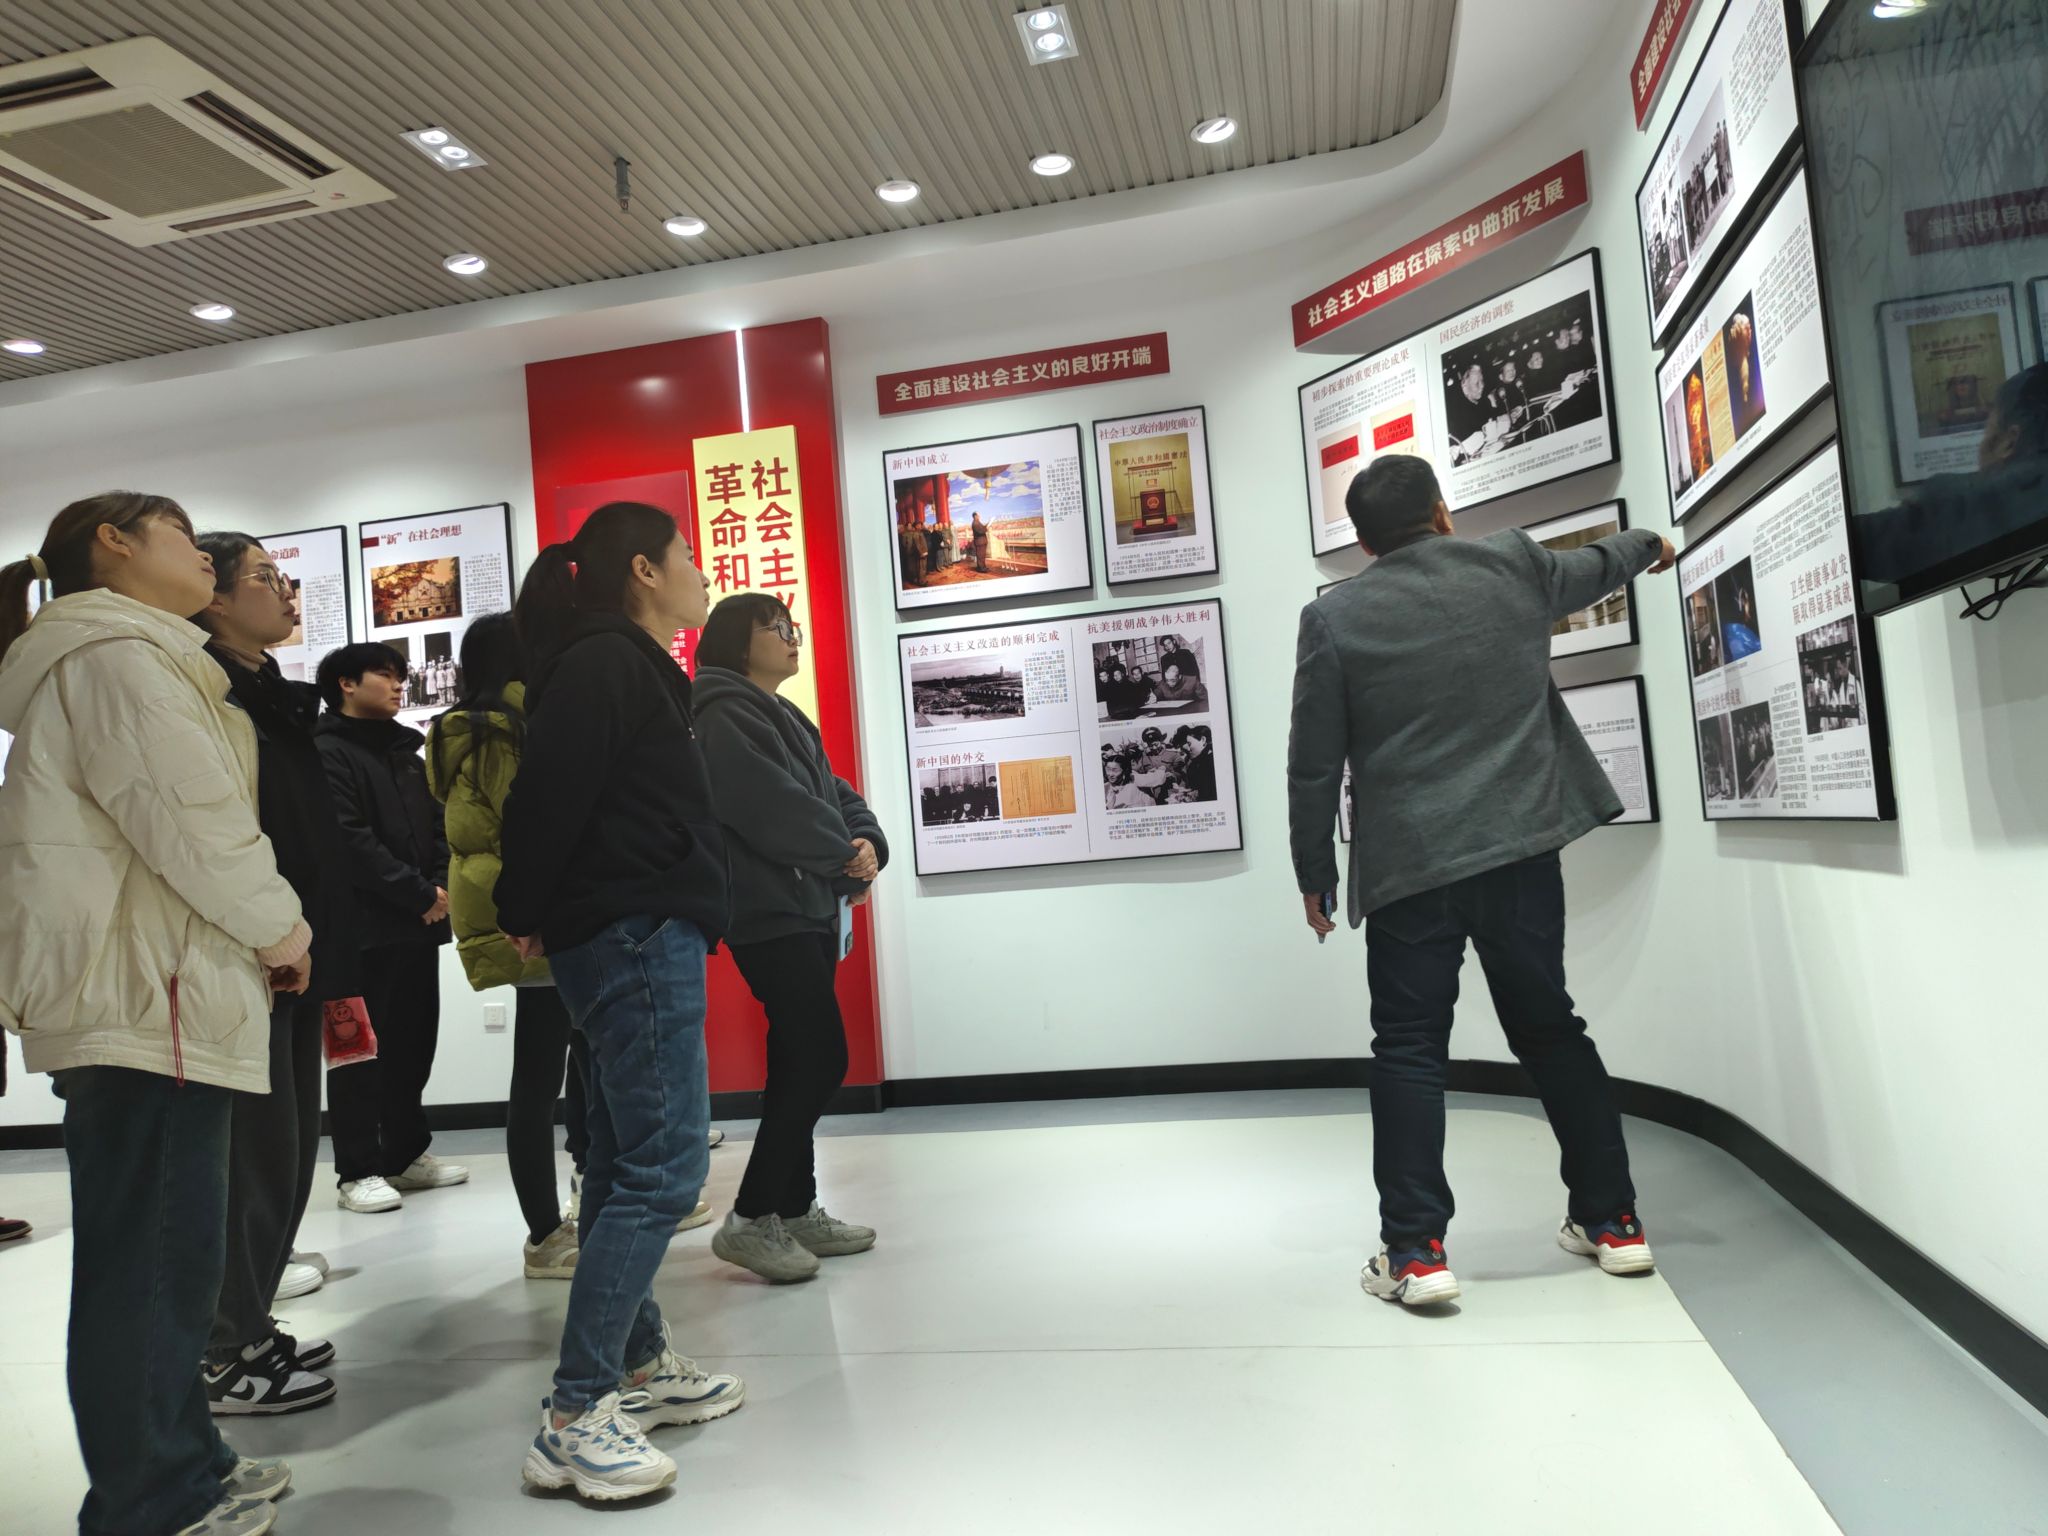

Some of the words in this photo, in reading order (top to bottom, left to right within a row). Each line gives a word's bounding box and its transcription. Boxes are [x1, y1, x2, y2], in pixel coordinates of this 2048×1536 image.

[1308, 177, 1565, 328] 社会主义道路在探索中曲折发展
[1440, 300, 1514, 345] 国民经济的调整
[894, 346, 1152, 402] 全面建设社会主义的良好开端
[1099, 416, 1199, 440] 社会主义政治制度确立
[892, 452, 950, 471] 新中国成立
[705, 463, 751, 593] 革命和
[267, 547, 300, 561] 命道路
[1790, 553, 1849, 600] 卫生健康事业发
[1088, 610, 1211, 634] 抗美援朝战争伟大胜利
[908, 630, 1060, 657] 社会主义主义改造的顺利完成
[916, 751, 985, 768] 新中国的外交
